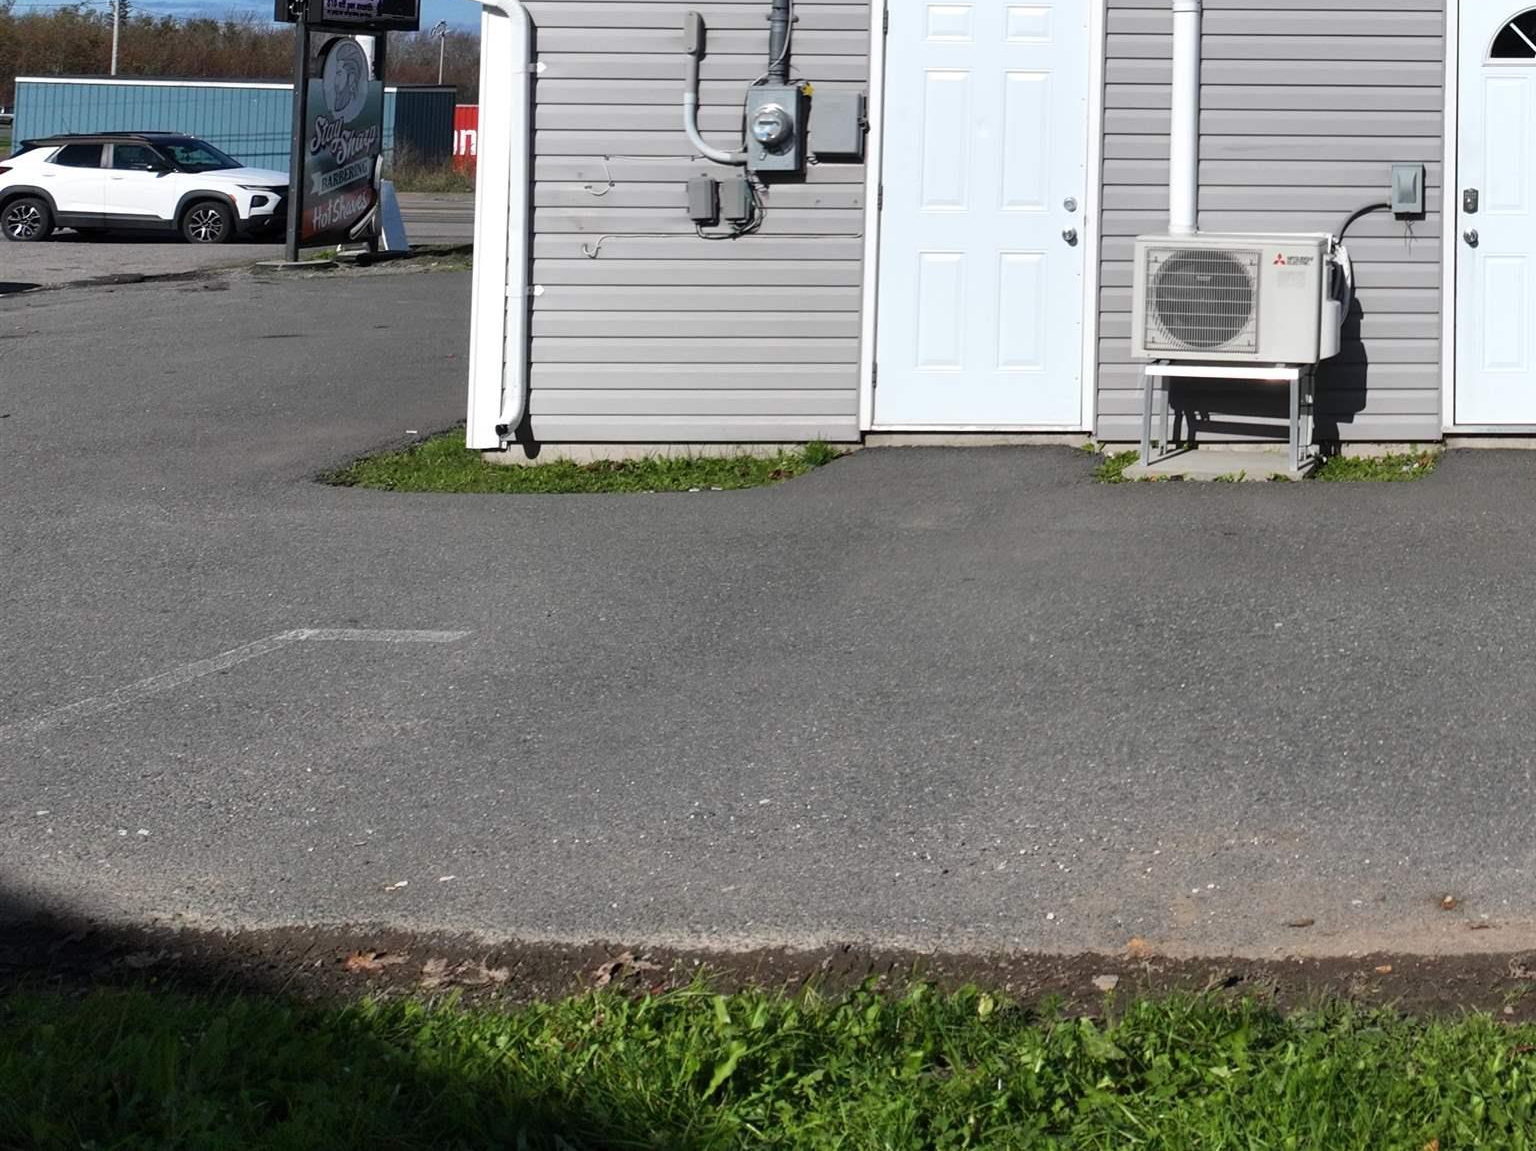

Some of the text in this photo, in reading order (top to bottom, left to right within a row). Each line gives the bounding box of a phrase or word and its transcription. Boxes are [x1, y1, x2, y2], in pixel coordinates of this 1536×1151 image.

[311, 116, 344, 154] Stay
[337, 125, 377, 165] Sharp
[321, 161, 368, 188] BARBERING
[312, 191, 368, 231] Hot Shaves
